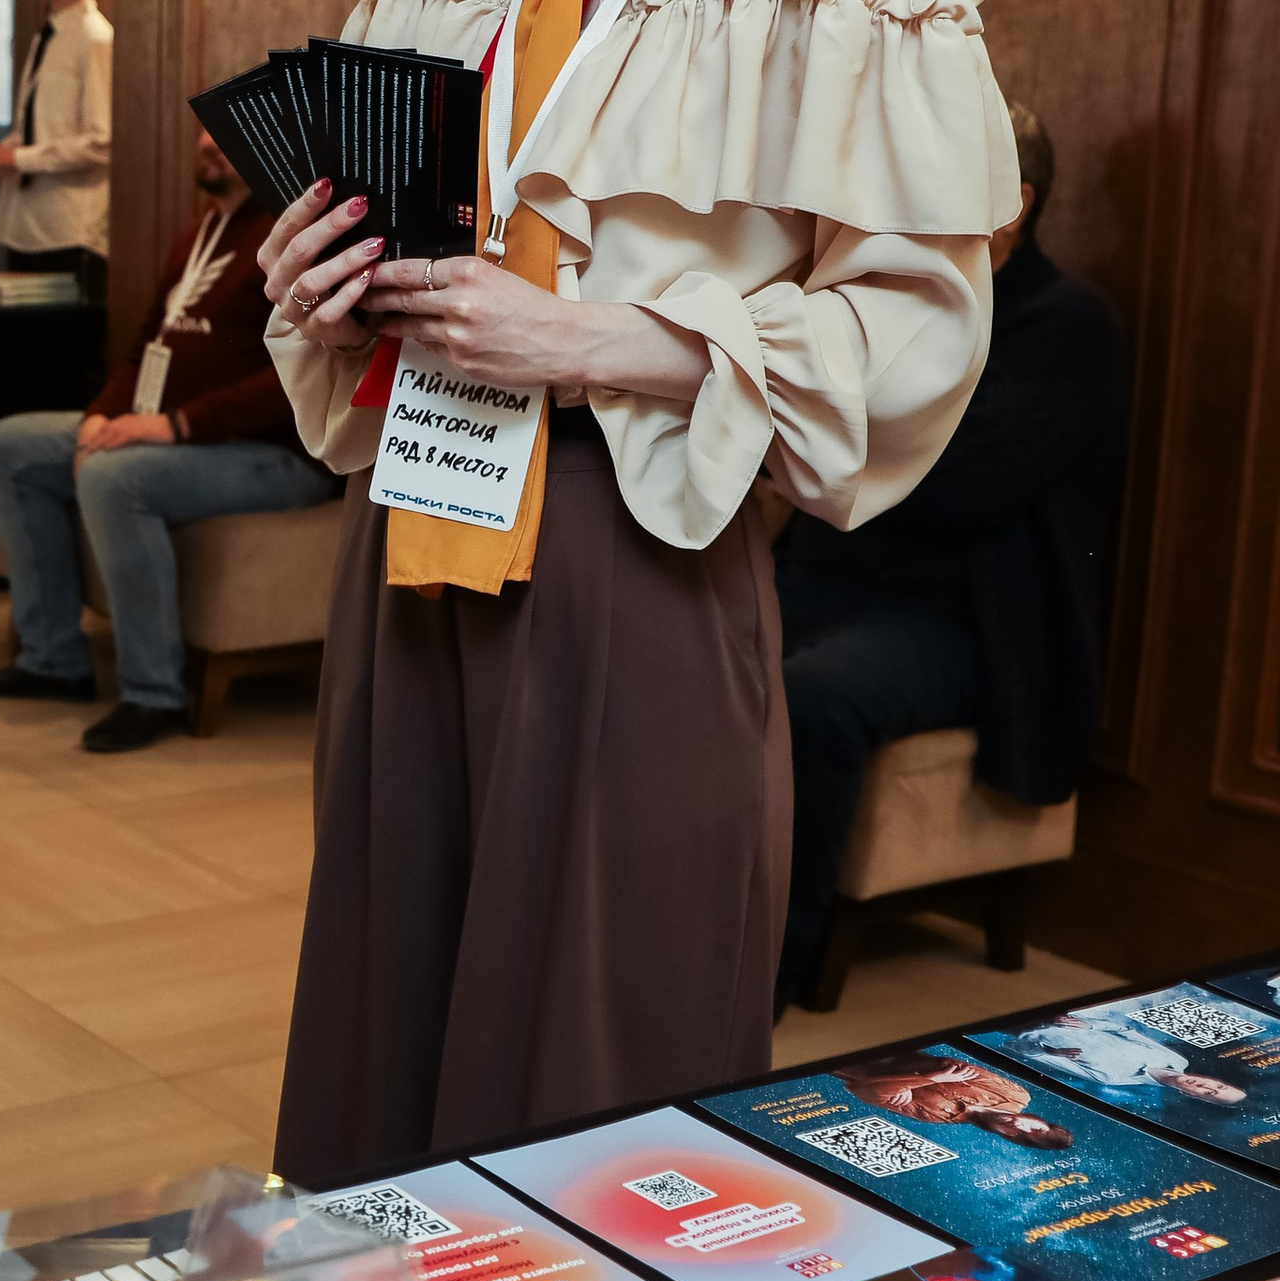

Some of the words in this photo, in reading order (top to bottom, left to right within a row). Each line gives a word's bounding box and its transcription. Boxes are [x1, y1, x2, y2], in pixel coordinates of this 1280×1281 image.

[398, 369, 531, 414] ГАЙНИЯРОВА
[392, 403, 499, 444] ВИКТОРИЯ
[385, 436, 421, 464] РЯД
[425, 446, 437, 464] 8
[381, 489, 443, 510] ТОЧКИ
[447, 503, 506, 524] РОСТА
[770, 1105, 850, 1124] Сканируй,
[972, 1174, 1014, 1190] 2025
[1028, 1171, 1089, 1195] Старт
[1159, 1178, 1217, 1200] Курс
[751, 1204, 794, 1221] стикер
[497, 1225, 524, 1236] для
[689, 1220, 740, 1238] подарок
[698, 1216, 799, 1248] Мотивационный
[423, 1232, 497, 1255] обработки
[671, 1236, 688, 1244] за
[472, 1254, 500, 1267] для
[520, 1257, 585, 1278] получите
